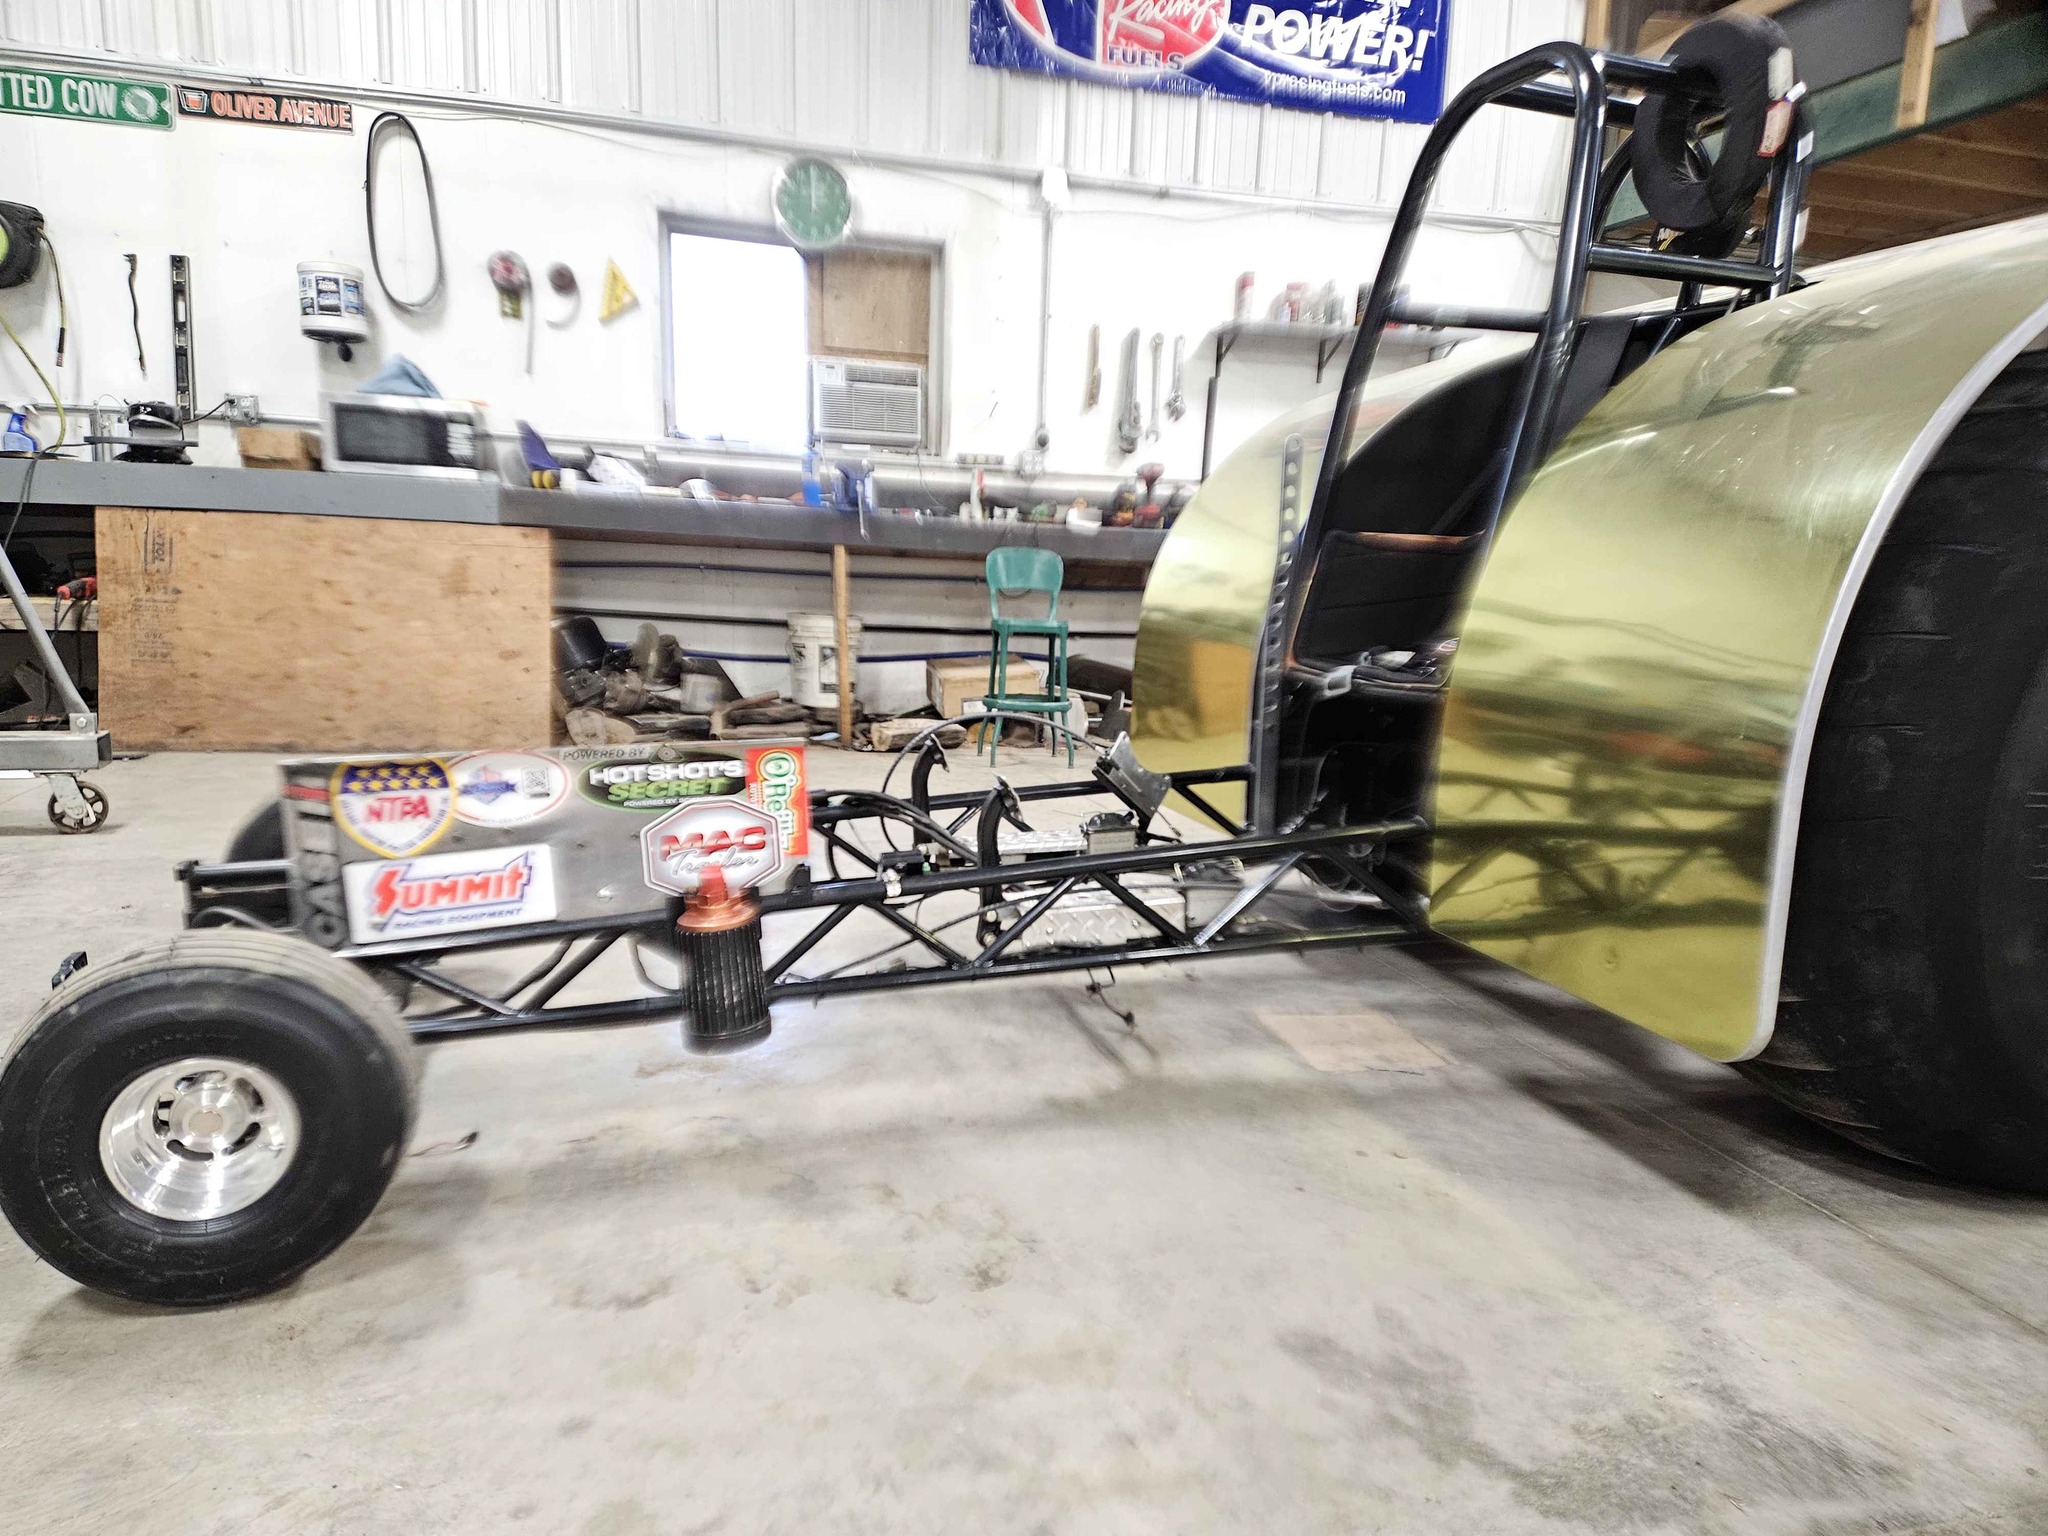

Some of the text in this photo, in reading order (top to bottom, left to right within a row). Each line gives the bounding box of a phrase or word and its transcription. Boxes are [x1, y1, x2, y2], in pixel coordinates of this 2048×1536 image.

[1241, 3, 1430, 71] POWER!
[1108, 44, 1184, 72] FUELS
[61, 79, 118, 119] COW
[1263, 71, 1407, 103] vpracingfuels.com
[210, 91, 353, 129] OLIVER AVENUE
[563, 747, 645, 761] POWERED BY
[607, 776, 729, 800] SECRET
[762, 754, 795, 848] O'Re
[365, 794, 432, 823] NTPA
[660, 826, 767, 861] MAC
